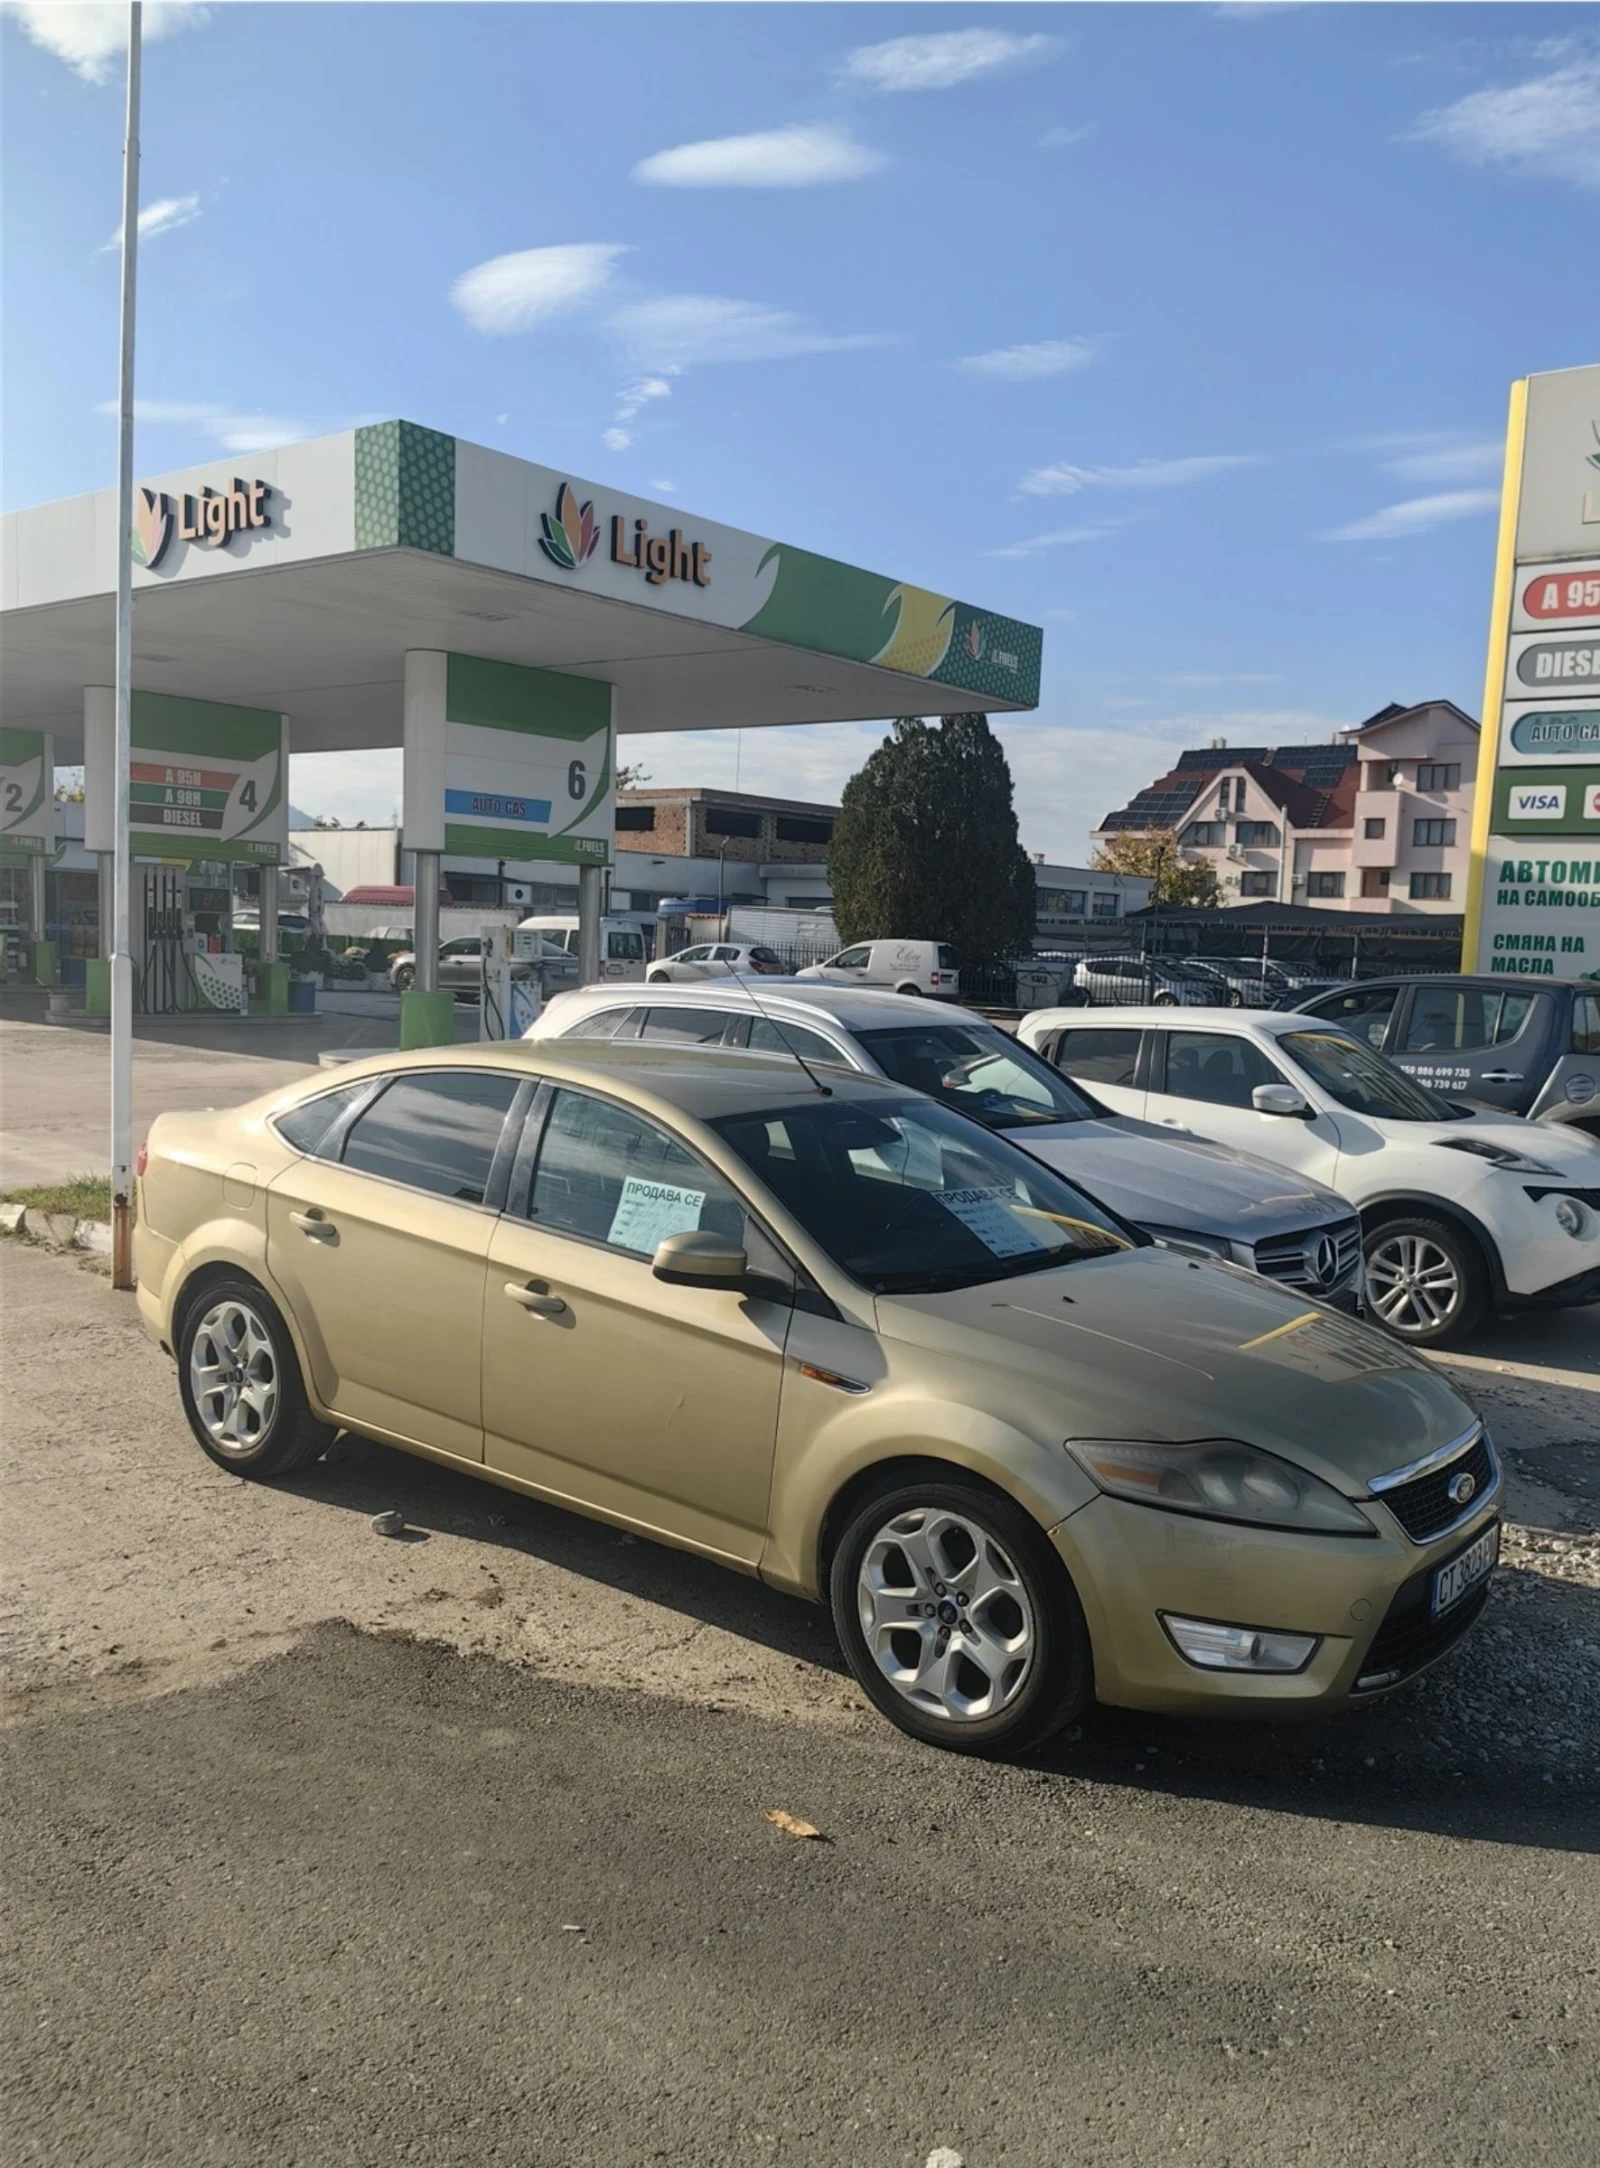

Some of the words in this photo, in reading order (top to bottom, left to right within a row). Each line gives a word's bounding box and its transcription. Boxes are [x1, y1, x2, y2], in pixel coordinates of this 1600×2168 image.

[178, 477, 268, 546] Light
[611, 514, 712, 587] Light
[1541, 583, 1559, 610] A
[1530, 725, 1573, 742] AUTO
[165, 768, 174, 784] A
[568, 760, 586, 800] 6
[5, 783, 23, 812] 2
[165, 788, 174, 804] A
[239, 780, 257, 813] 4
[1518, 795, 1560, 810] VISA
[472, 797, 500, 813] AUTO
[505, 801, 527, 817] GAS
[163, 808, 202, 826] DIESEL
[1497, 889, 1520, 906] НА
[1493, 934, 1556, 952] СМЯНА
[1561, 936, 1585, 953] НА
[1491, 956, 1554, 975] МАСЛА
[1435, 1067, 1452, 1077] 699
[1454, 1068, 1471, 1078] 735
[1434, 1080, 1450, 1089] 739
[1452, 1081, 1467, 1090] 617
[626, 1182, 681, 1202] ПРОДАВА
[684, 1193, 701, 1207] СЕ
[934, 1187, 1000, 1205] ПРОДАВА
